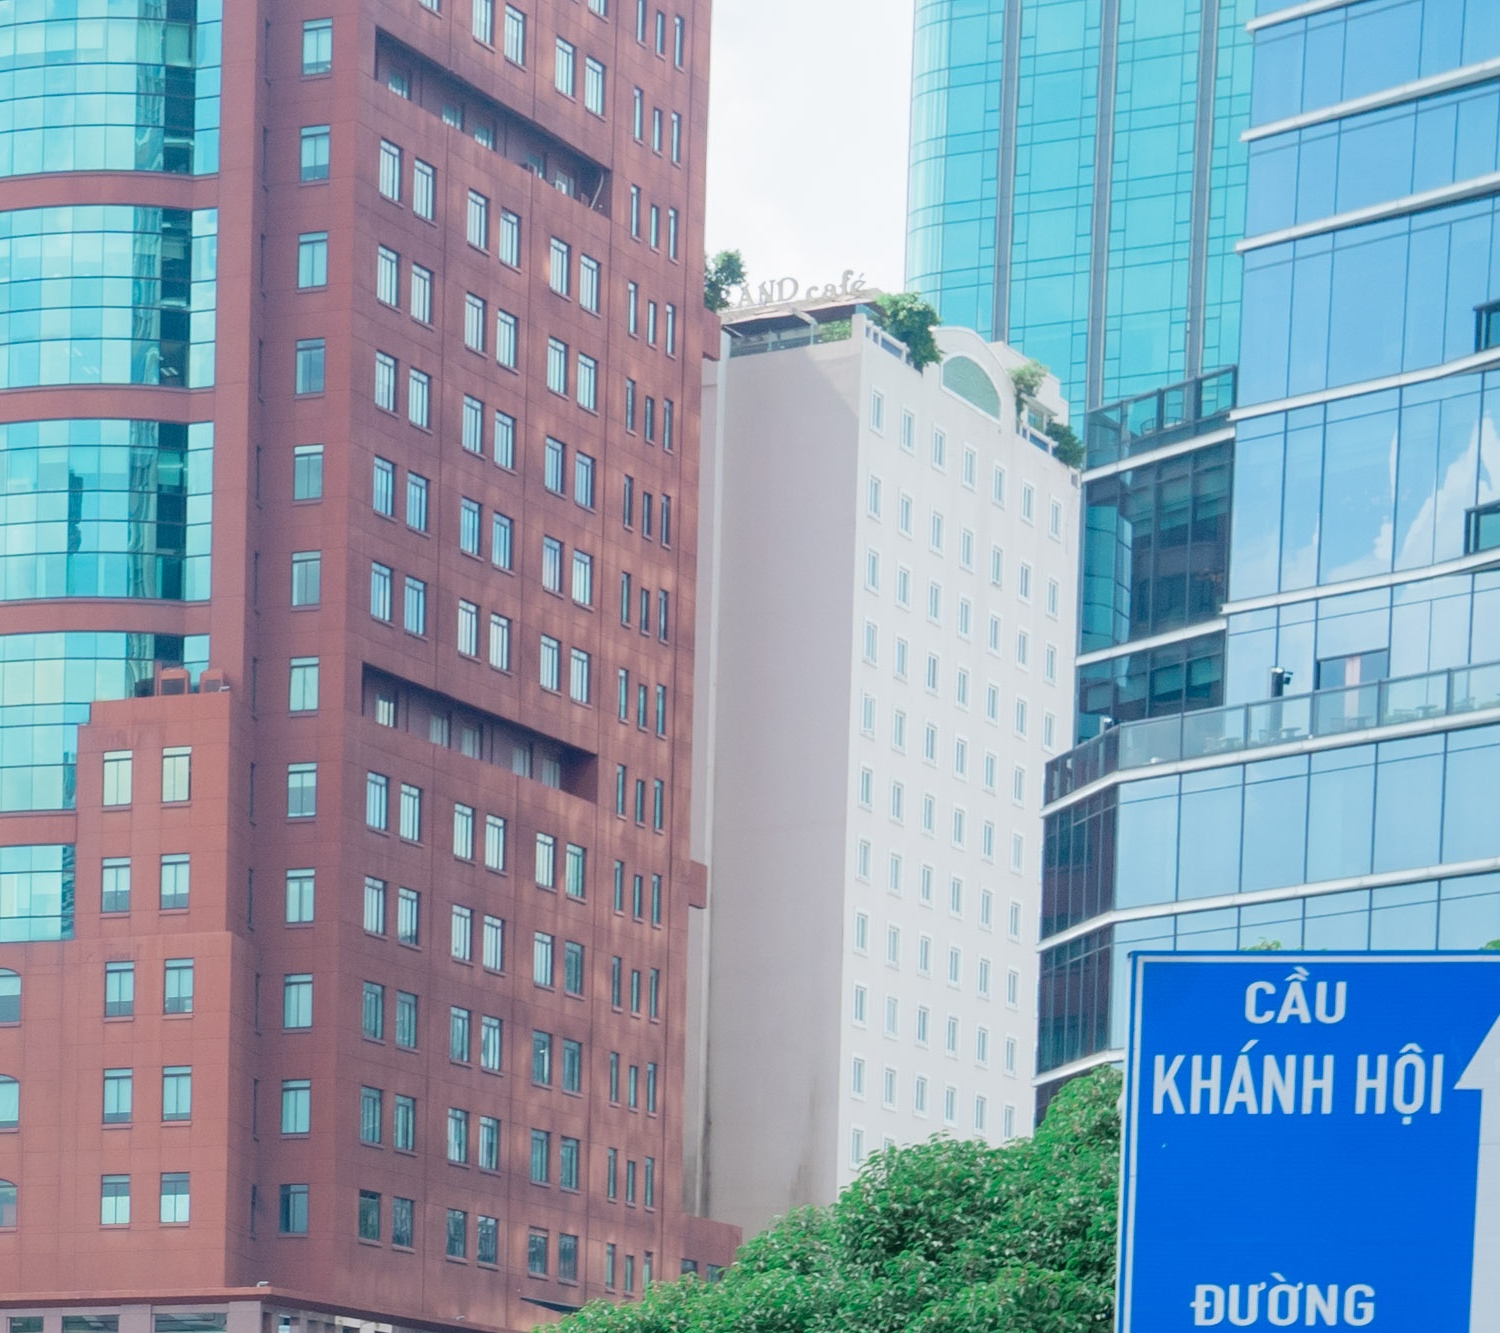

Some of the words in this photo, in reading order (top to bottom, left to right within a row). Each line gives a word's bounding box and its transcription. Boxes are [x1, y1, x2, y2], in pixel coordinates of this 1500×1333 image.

[805, 269, 866, 301] café
[1244, 966, 1347, 1024] CẦU
[1152, 1039, 1334, 1115] KHÁNH
[1354, 1042, 1445, 1125] HỘI
[1190, 1272, 1376, 1327] ĐƯỜNG
